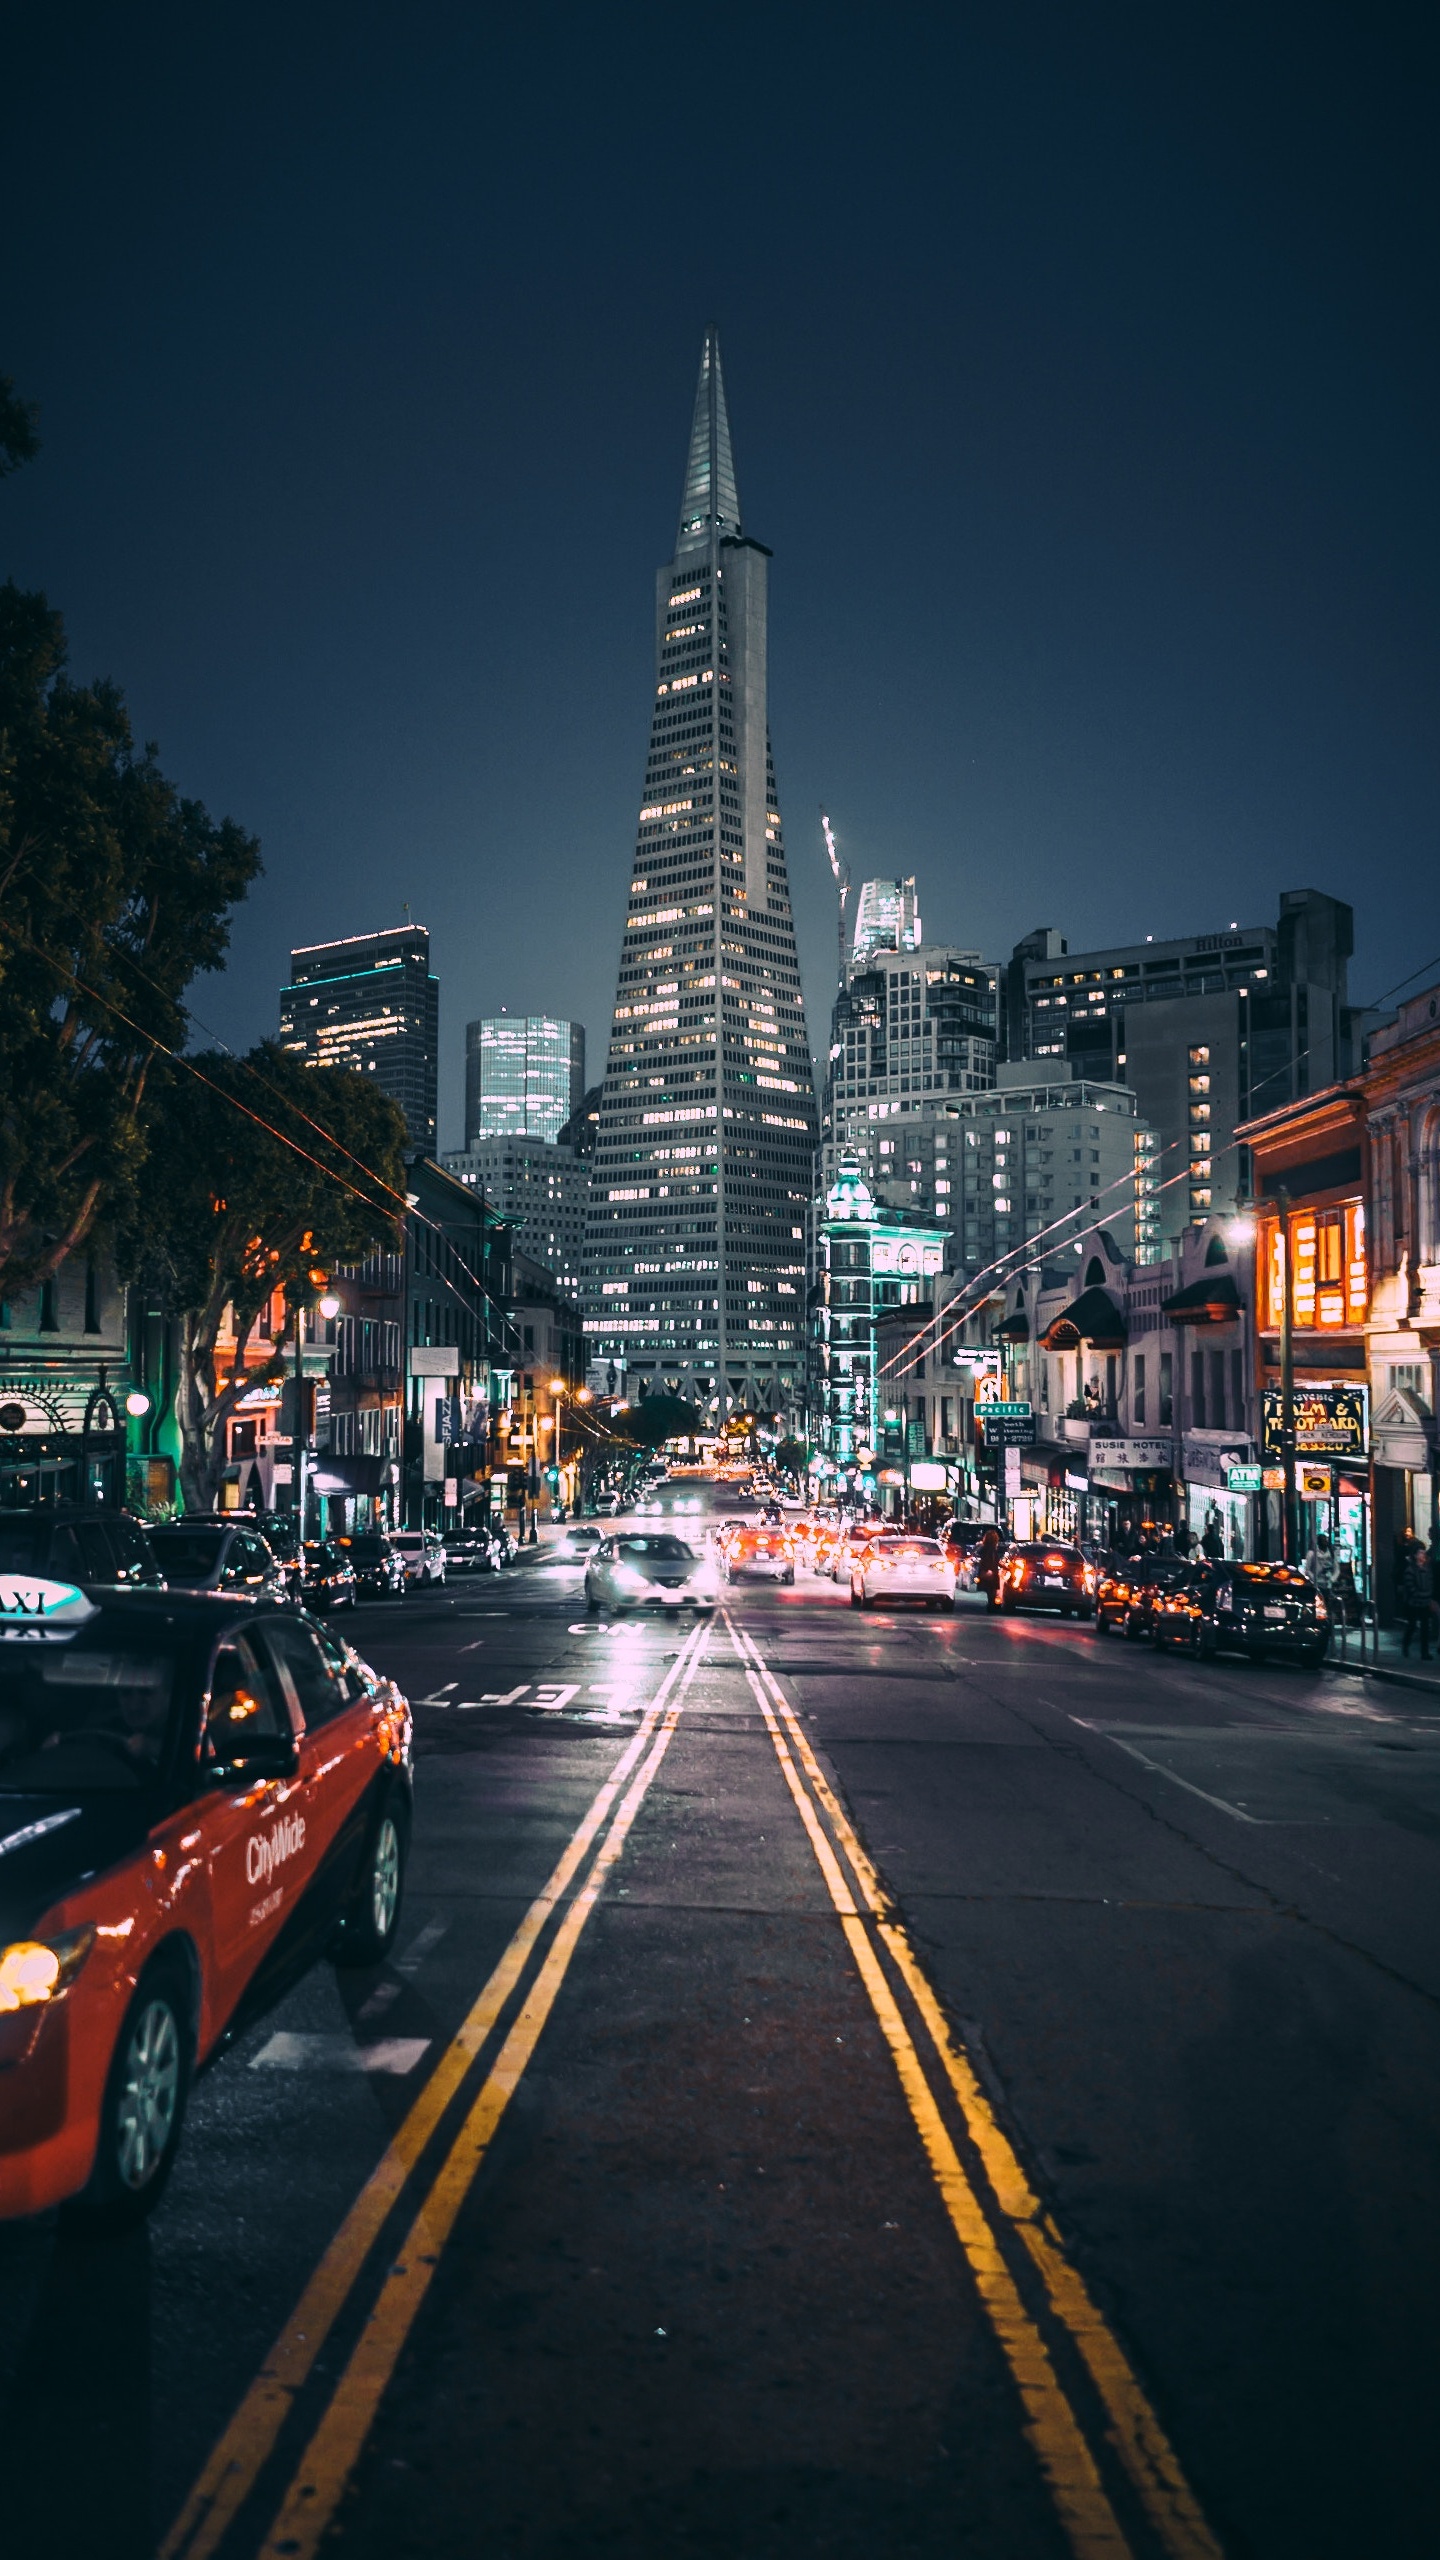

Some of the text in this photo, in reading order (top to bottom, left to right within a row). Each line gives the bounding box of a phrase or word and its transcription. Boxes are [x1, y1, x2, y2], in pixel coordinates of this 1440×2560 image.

[1196, 936, 1242, 952] Hilton
[1293, 1393, 1335, 1402] SYCHIC
[980, 1405, 1024, 1413] Pacific
[1335, 1403, 1349, 1416] &
[442, 1397, 452, 1444] SFJAZZ
[1095, 1441, 1167, 1449] SUSIE HOTEL
[1230, 1468, 1258, 1481] ATM
[246, 1810, 306, 1884] CityWide
